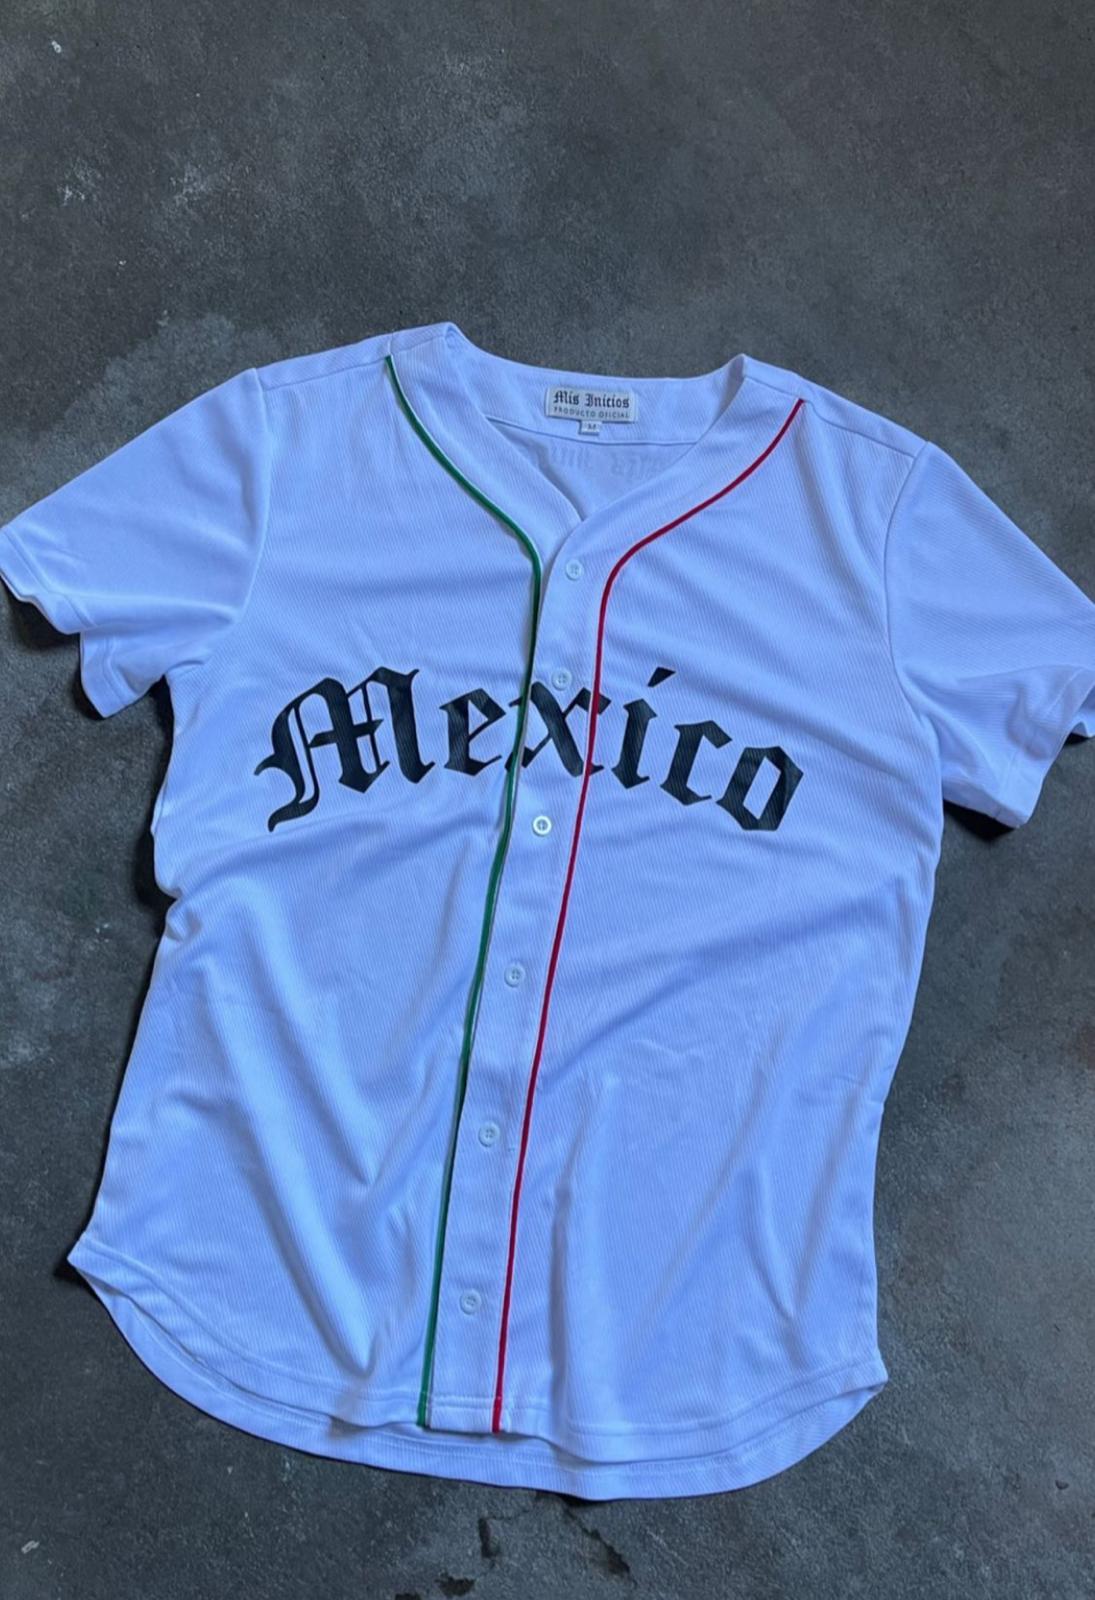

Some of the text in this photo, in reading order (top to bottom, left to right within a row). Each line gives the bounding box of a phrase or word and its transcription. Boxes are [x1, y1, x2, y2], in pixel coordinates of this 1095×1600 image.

[553, 390, 630, 409] Mis Inicios
[553, 407, 630, 419] PRODUCTO OFICIAL
